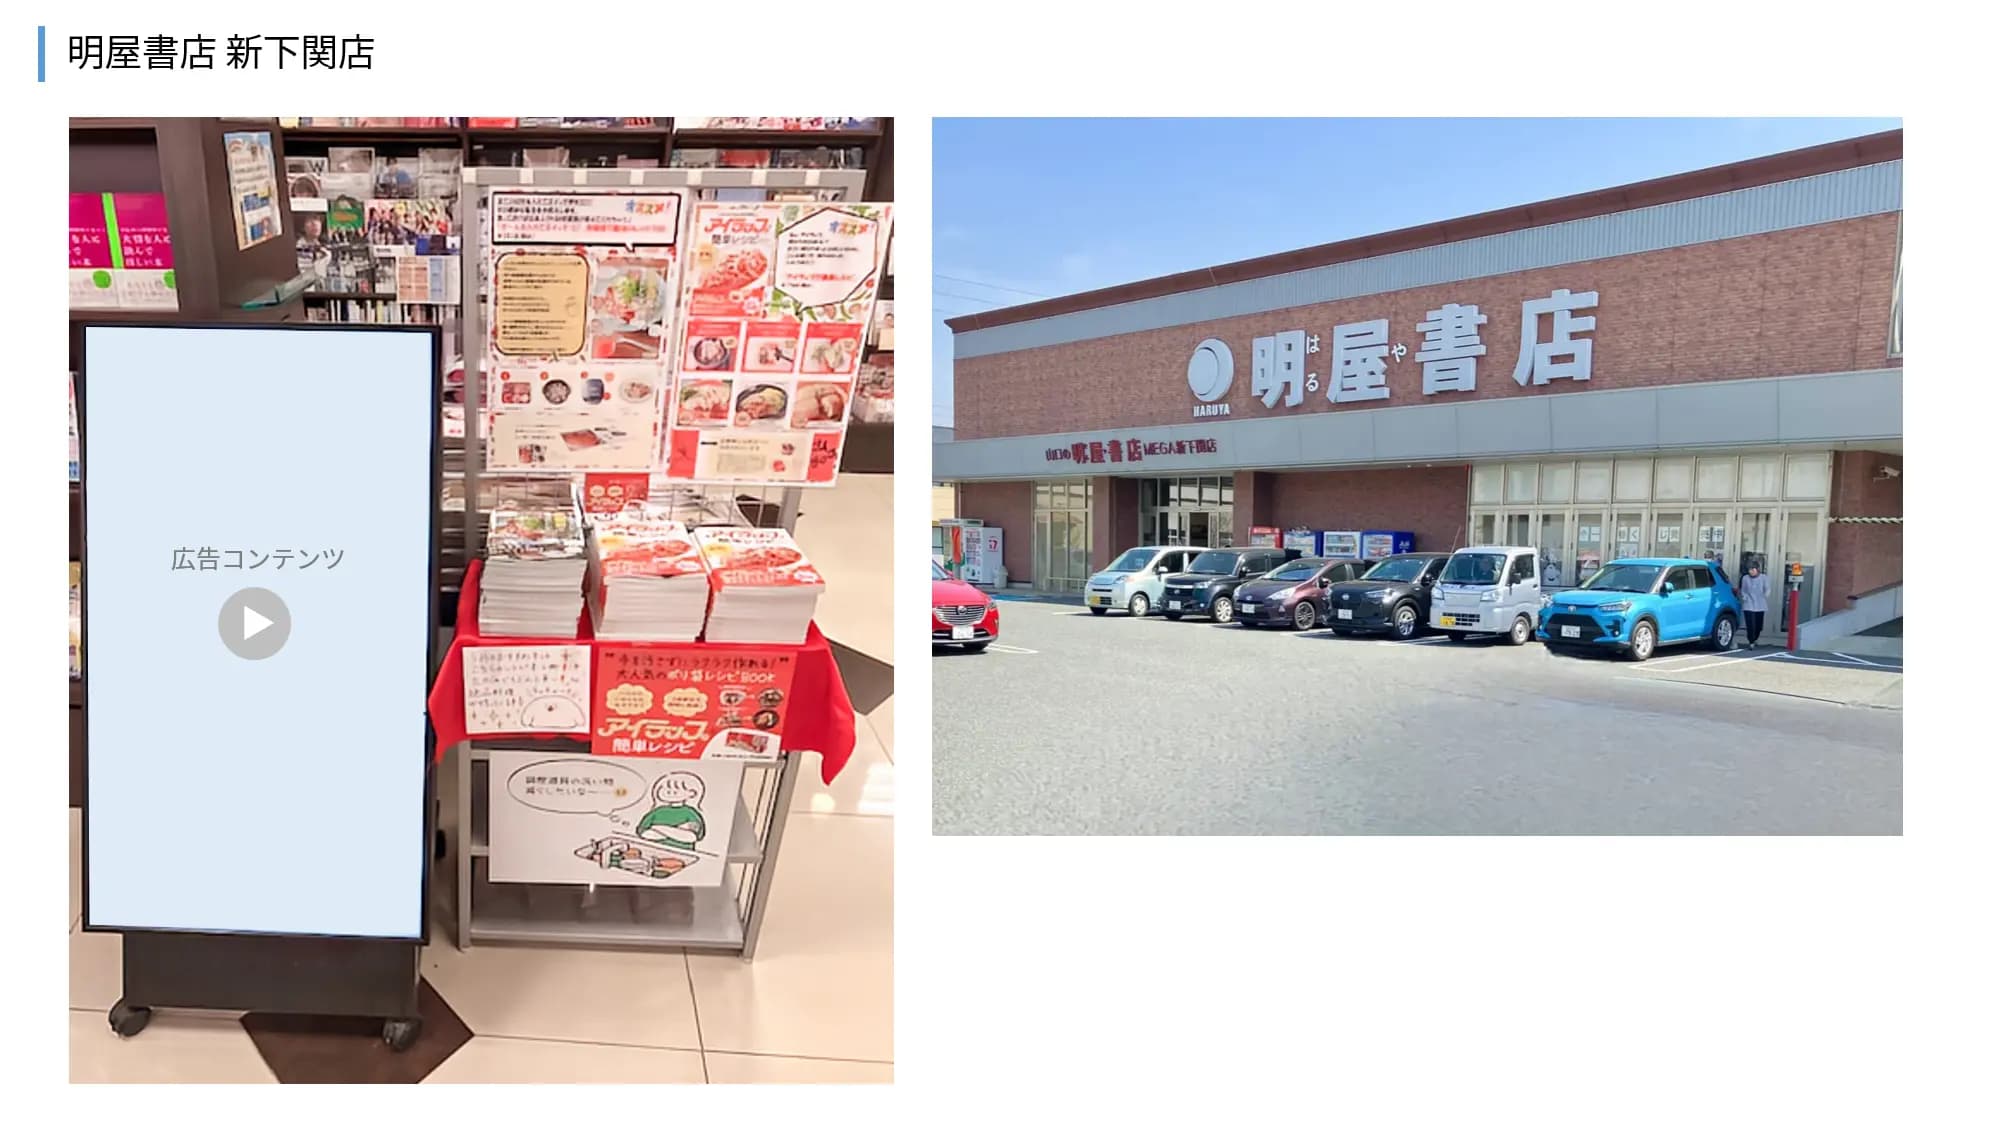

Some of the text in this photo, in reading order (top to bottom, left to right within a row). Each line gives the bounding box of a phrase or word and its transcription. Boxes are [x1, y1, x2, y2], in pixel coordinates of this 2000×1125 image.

[1251, 289, 1599, 409] 明屋書店
[1193, 404, 1231, 417] HARUYA
[171, 546, 345, 571] 広告コンテンツ
[612, 738, 697, 754] 簡単レシピ
